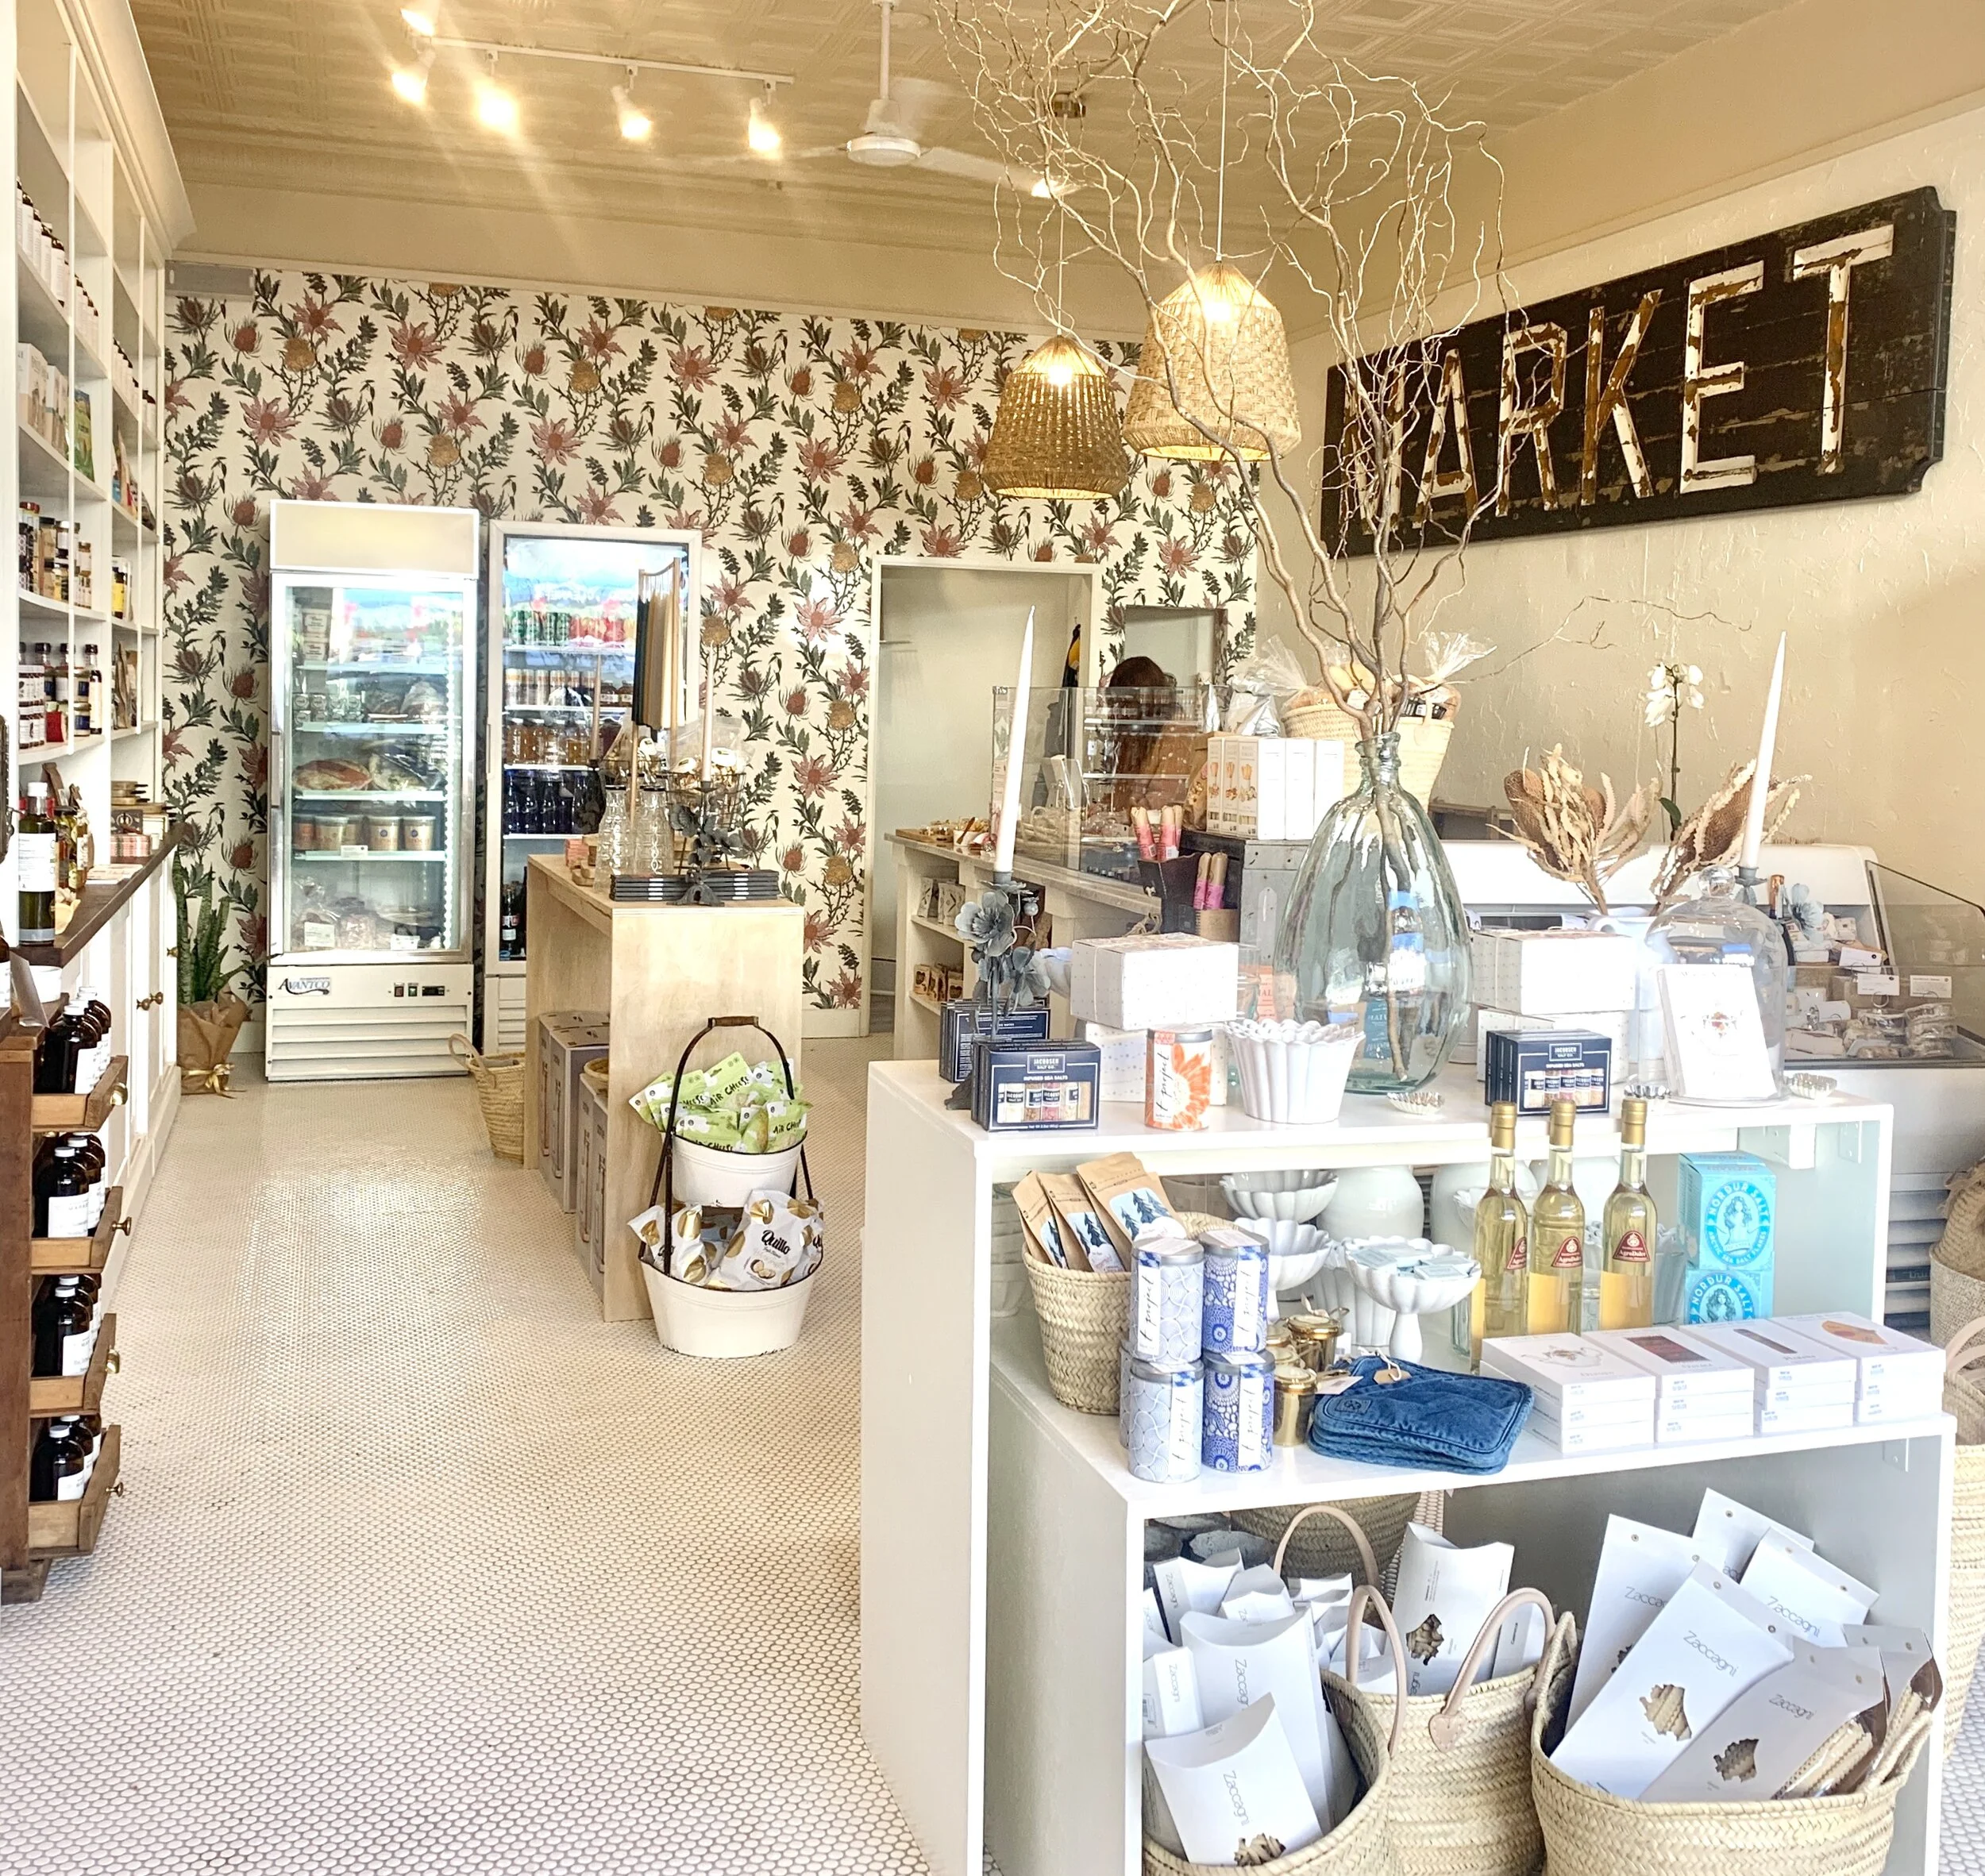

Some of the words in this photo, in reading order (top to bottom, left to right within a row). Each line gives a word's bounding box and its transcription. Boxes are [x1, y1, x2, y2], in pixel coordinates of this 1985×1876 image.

[1339, 223, 1894, 535] MARKET
[279, 978, 330, 995] AVANTCO
[1157, 1052, 1174, 1098] project
[1708, 1181, 1748, 1215] NORDUR
[1752, 1189, 1770, 1217] SALT
[761, 1230, 791, 1255] Quillo
[1722, 1254, 1734, 1264] SEA
[1736, 1253, 1752, 1264] SALT
[1142, 1275, 1158, 1327] project
[1692, 1274, 1732, 1306] NORDUR
[1734, 1285, 1753, 1313] SALT
[1682, 1630, 1740, 1677] Zaccagni
[1169, 1663, 1180, 1703] Zaccagni
[1768, 1693, 1817, 1720] Zaccagni
[1223, 1770, 1250, 1826] Zaccagni
